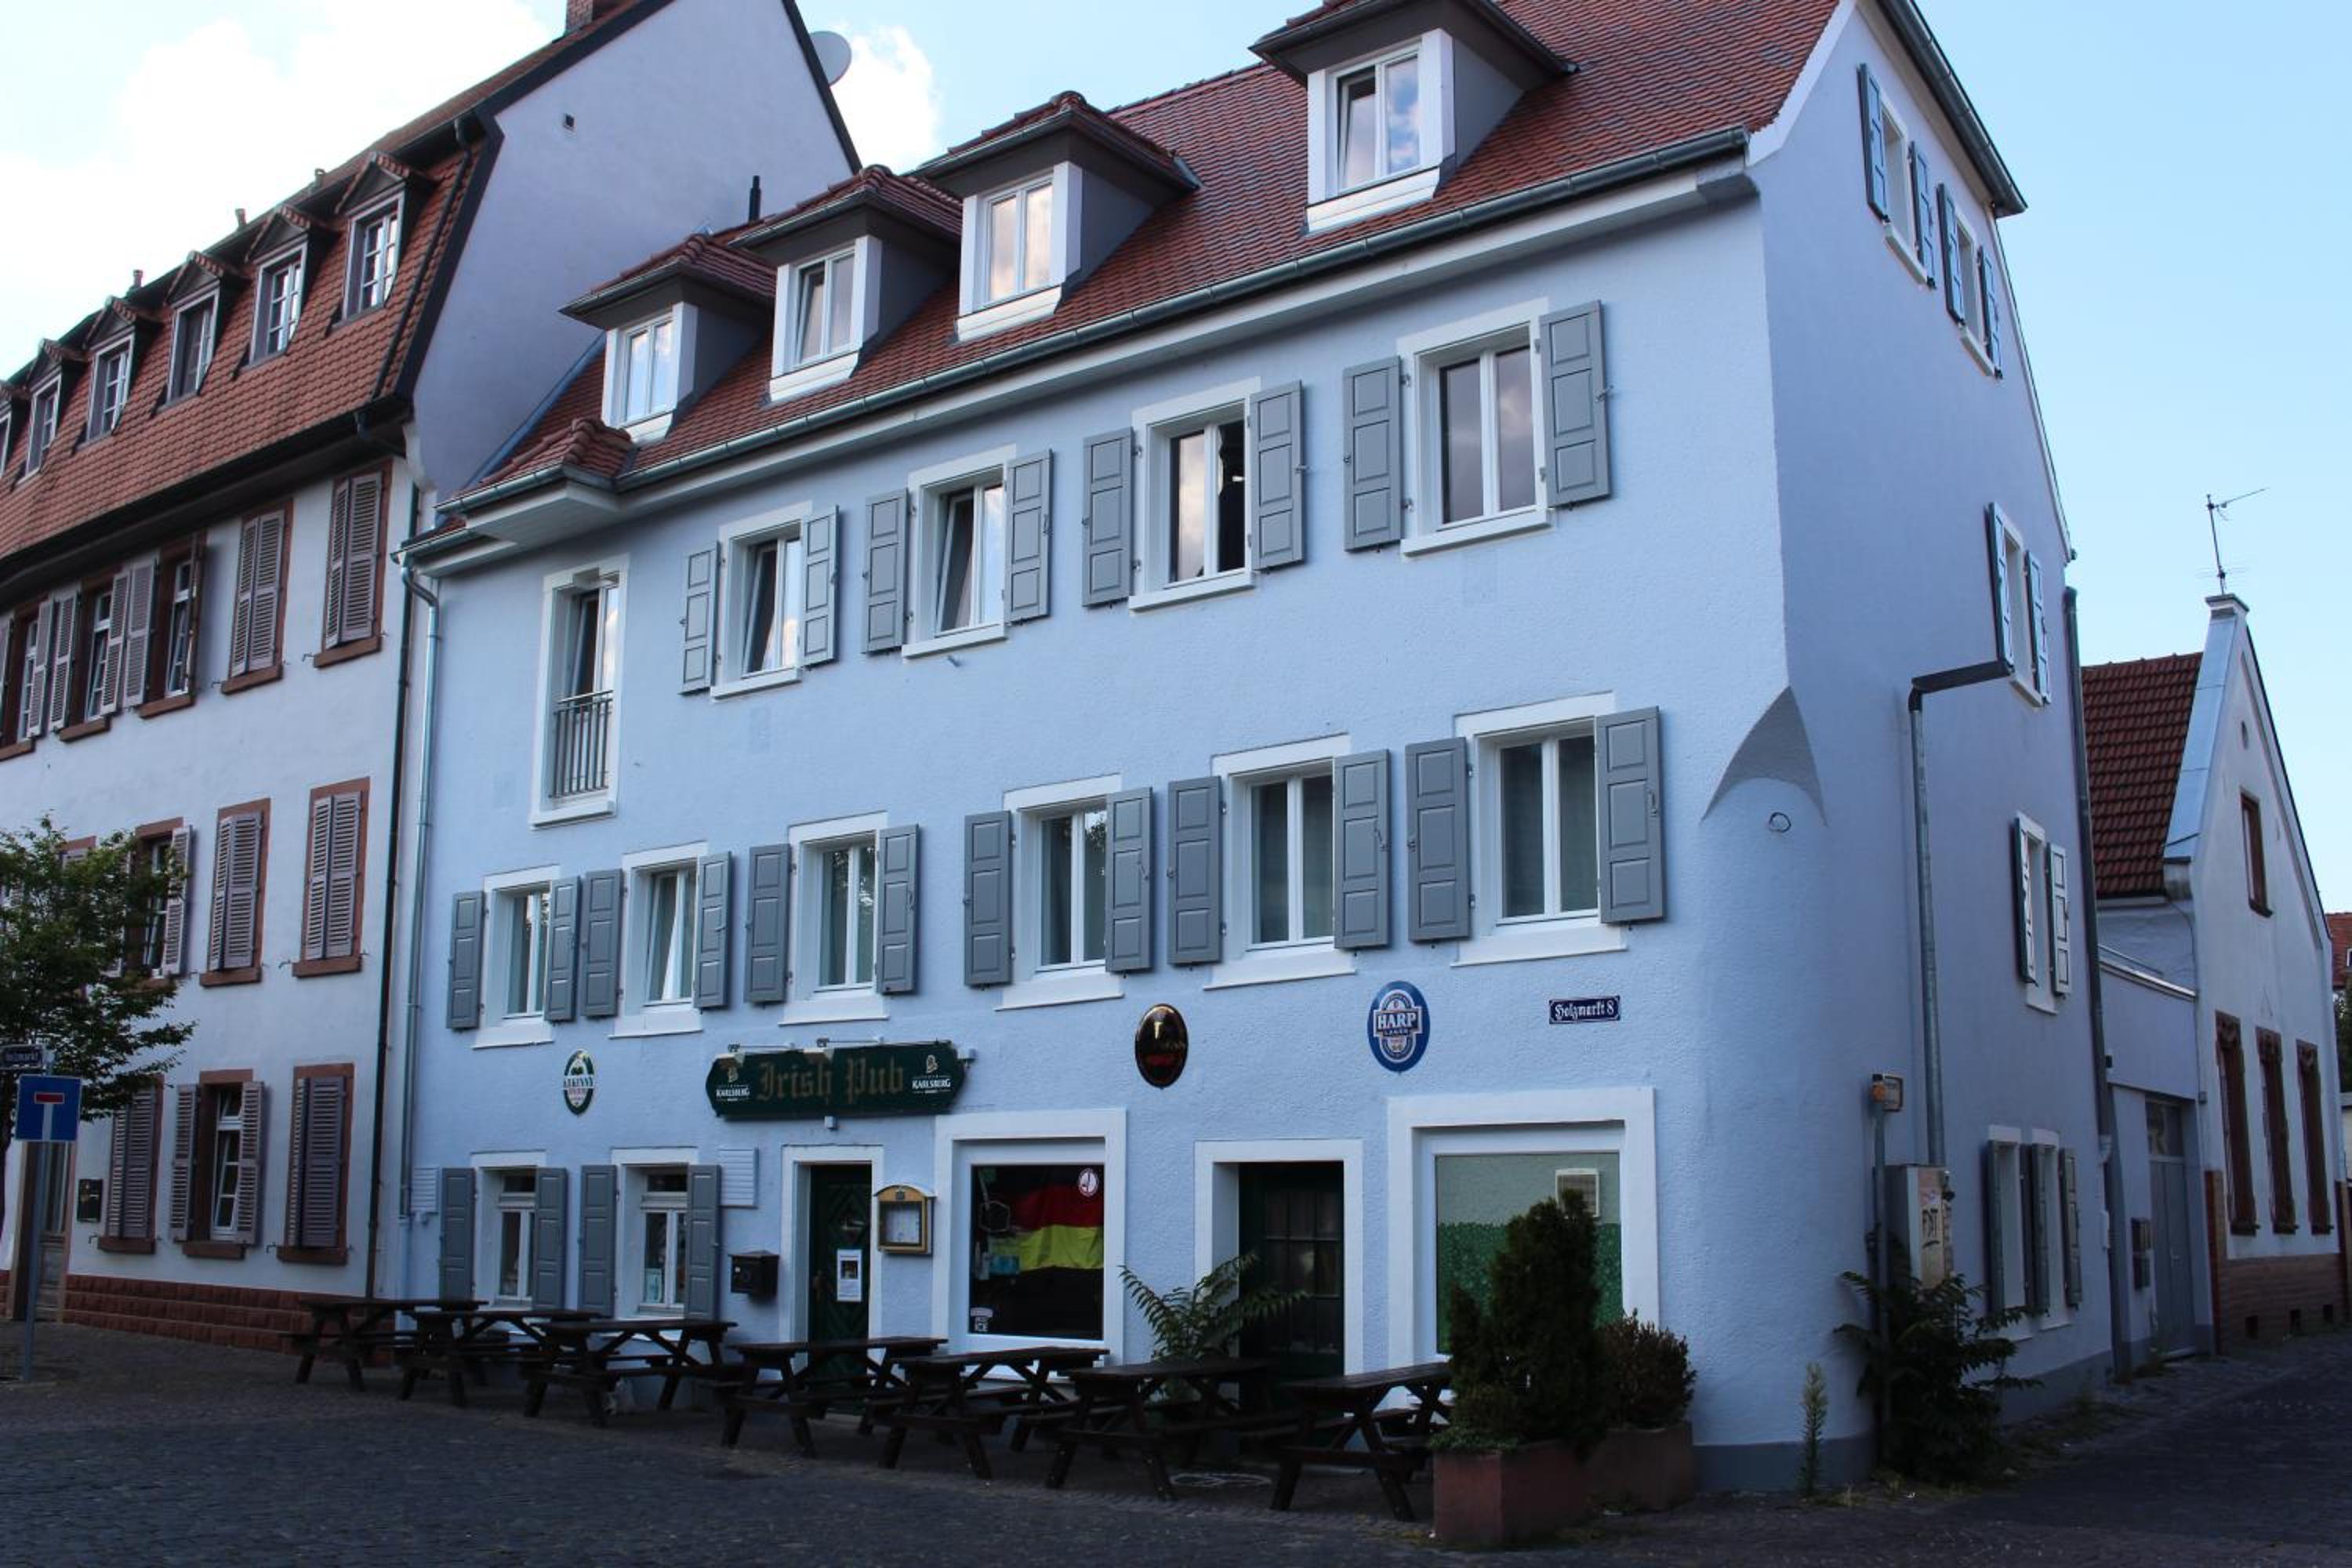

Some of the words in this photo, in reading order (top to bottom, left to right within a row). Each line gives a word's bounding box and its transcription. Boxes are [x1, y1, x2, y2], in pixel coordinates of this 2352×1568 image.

[1554, 1001, 1605, 1021] Holzmarkt
[1606, 1000, 1614, 1015] 8
[1377, 1012, 1417, 1029] HARP
[756, 1060, 833, 1105] Irish
[844, 1054, 904, 1104] Pub
[911, 1078, 951, 1090] KARLSBERG
[715, 1087, 750, 1098] KARLSBERG
